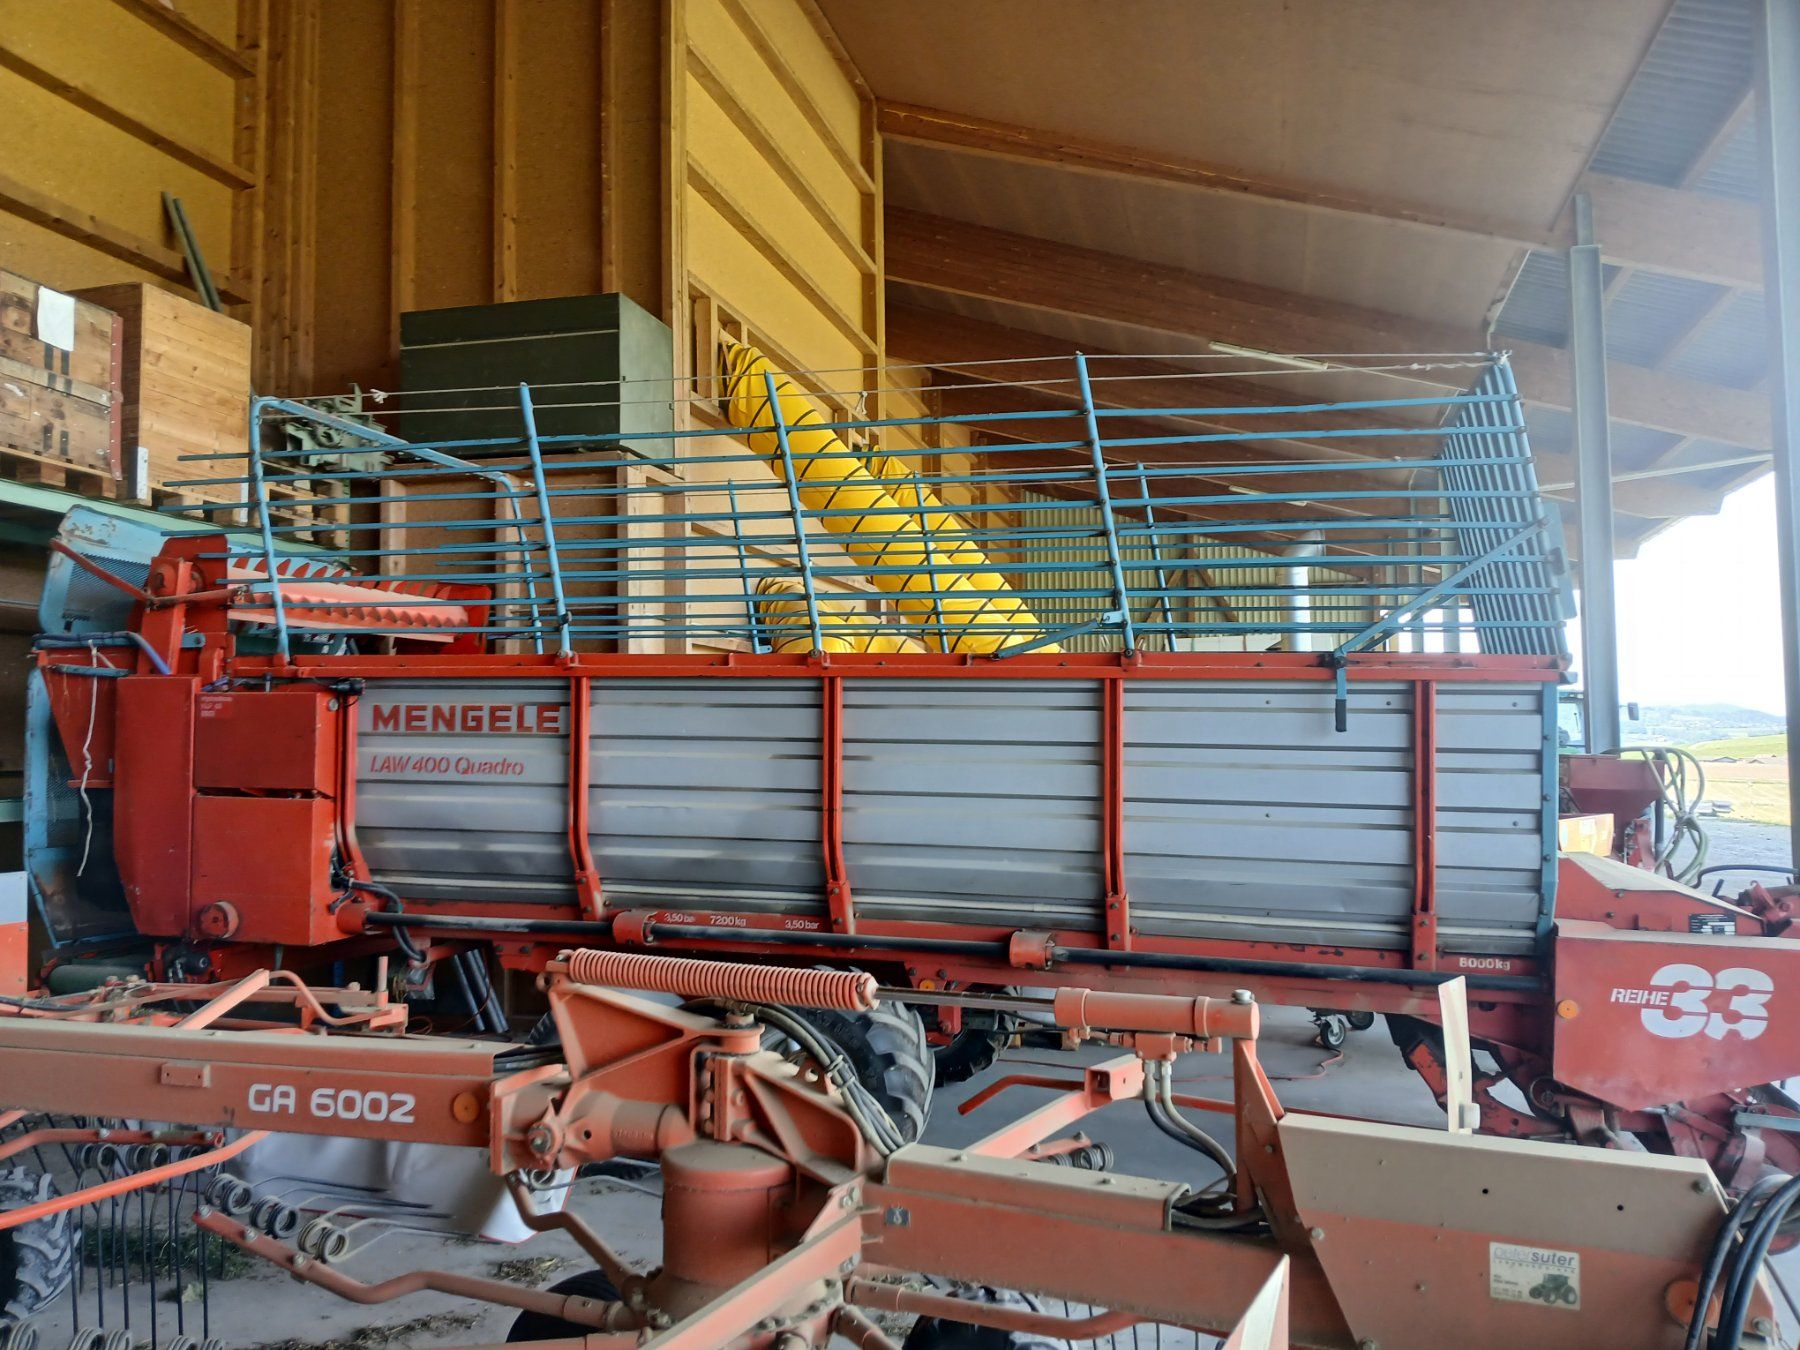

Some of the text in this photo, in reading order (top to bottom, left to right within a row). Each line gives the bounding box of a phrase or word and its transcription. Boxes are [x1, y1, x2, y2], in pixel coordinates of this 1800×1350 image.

[373, 704, 561, 733] MENGELE
[370, 755, 524, 776] LAW 400 Quadro
[1610, 963, 1775, 1040] REIHE 33
[248, 1083, 416, 1123] GA 6002
